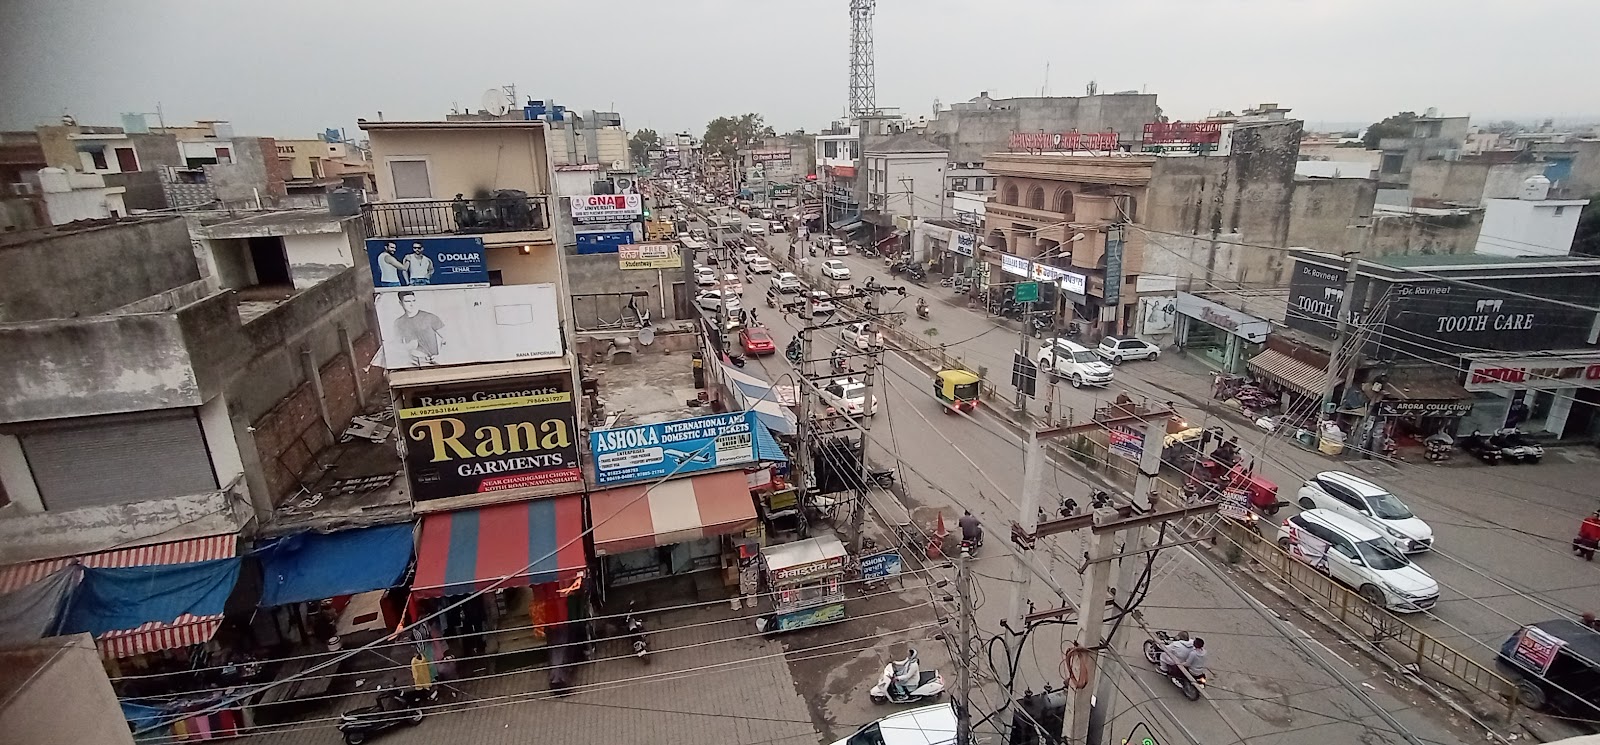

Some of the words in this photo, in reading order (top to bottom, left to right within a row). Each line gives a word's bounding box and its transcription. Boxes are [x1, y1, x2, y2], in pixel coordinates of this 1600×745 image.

[588, 196, 615, 206] GNA
[446, 253, 480, 261] DOLLAR
[1312, 268, 1339, 282] Ravneet
[1414, 285, 1451, 296] Ravneet
[1298, 295, 1335, 319] TOOTH
[1437, 315, 1489, 332] TOOTH
[1493, 313, 1535, 330] CARE
[1426, 403, 1472, 411] COLLECTION
[664, 417, 727, 433] INTERNATIONAL
[728, 414, 746, 425] AND
[409, 418, 572, 463] Rana
[597, 426, 660, 452] ASHOKA
[661, 430, 701, 444] DOMESTIC
[702, 426, 717, 438] AIR
[718, 422, 750, 435] TICKETS
[458, 452, 564, 477] GARMENTS
[503, 474, 548, 484] CHANDIGARH
[861, 556, 887, 567] ASHOKA
